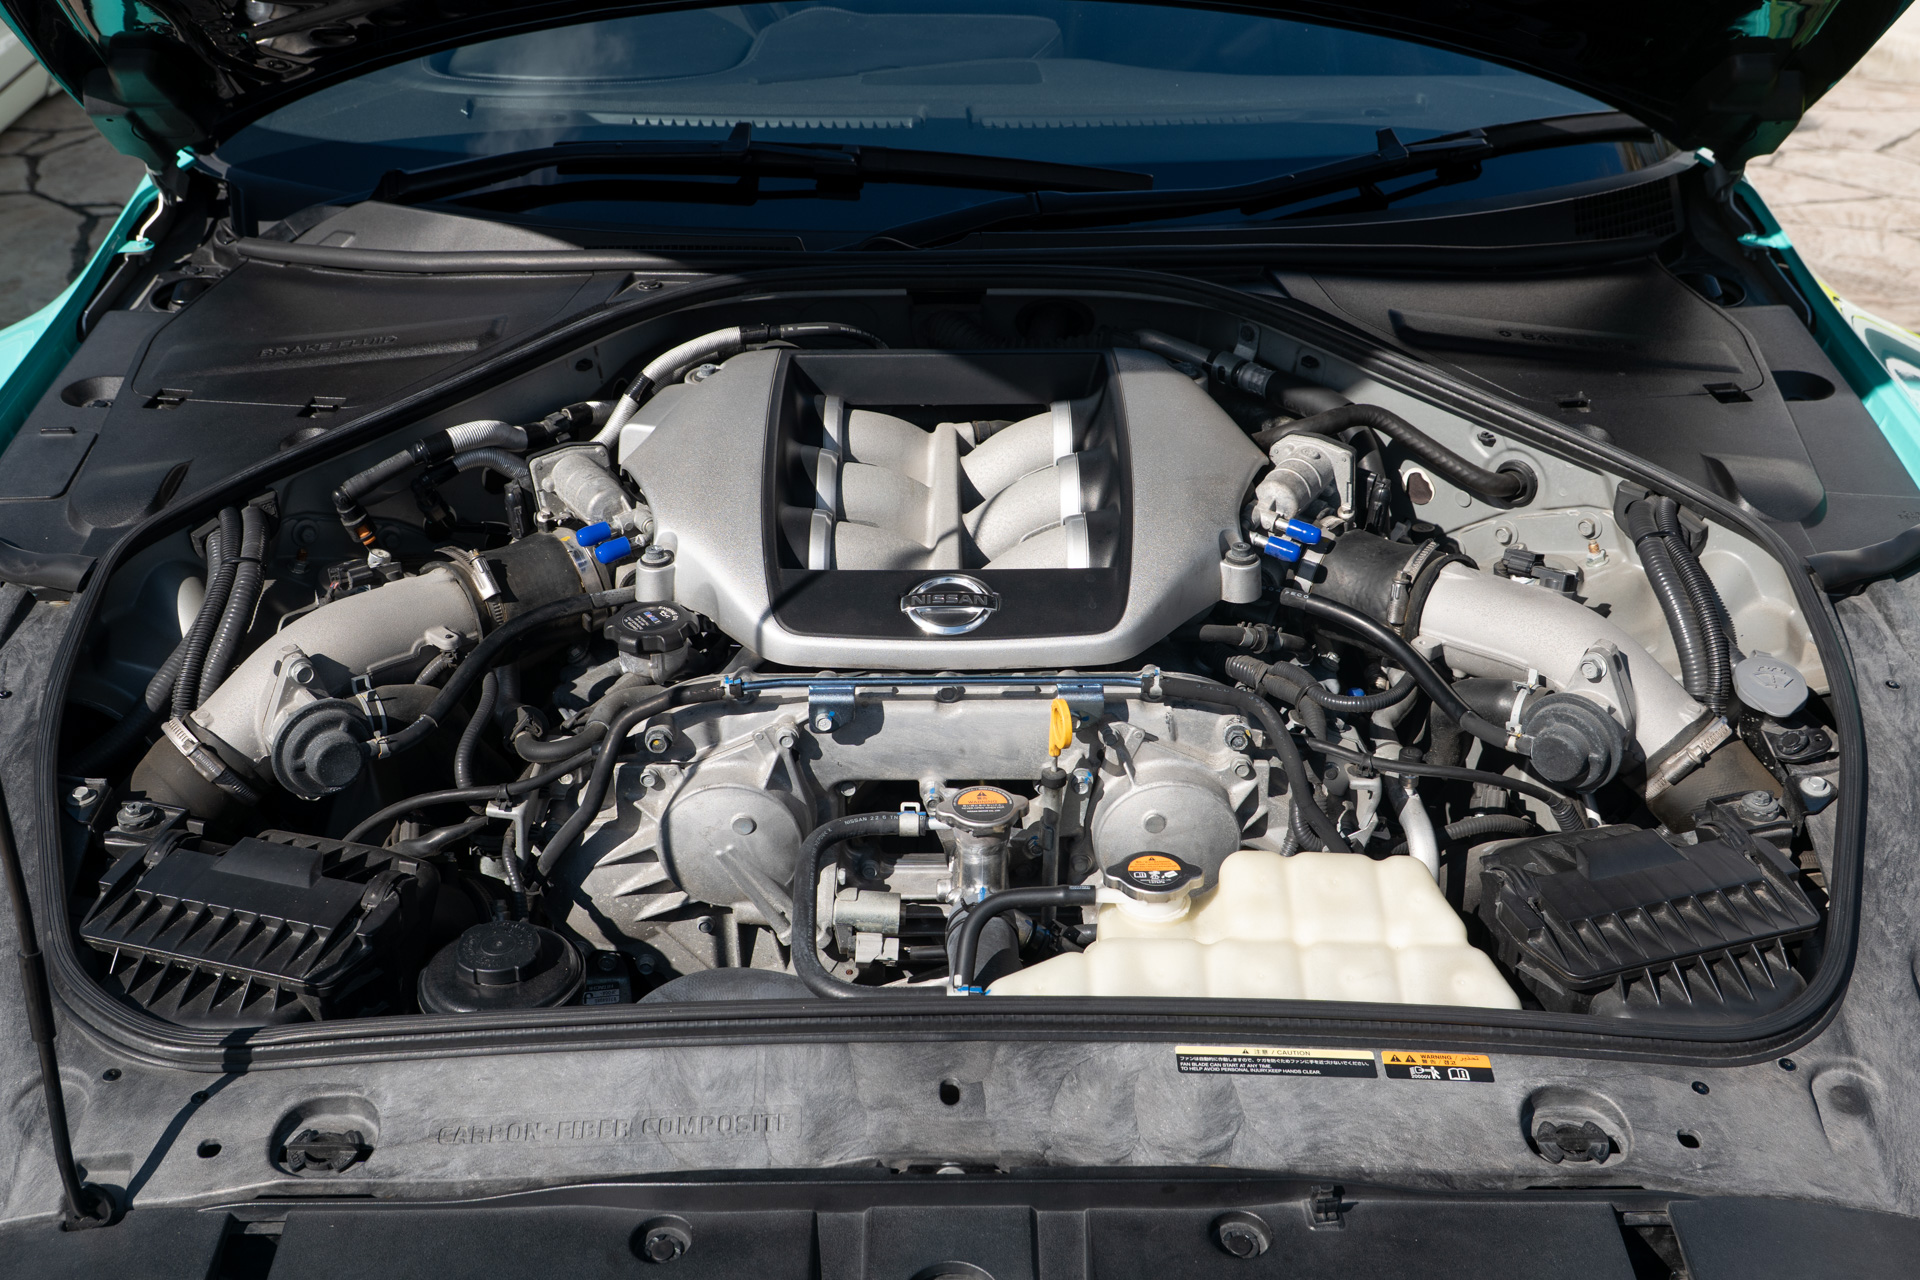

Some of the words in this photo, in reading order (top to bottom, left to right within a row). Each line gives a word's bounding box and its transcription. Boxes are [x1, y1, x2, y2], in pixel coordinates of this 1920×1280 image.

[259, 342, 332, 357] BRAKE
[338, 335, 398, 349] FLUID
[911, 594, 988, 606] NISSAN
[844, 815, 868, 825] NISSAN
[437, 1117, 632, 1145] CARBON-FIBER
[641, 1112, 795, 1137] COMPOSITE
